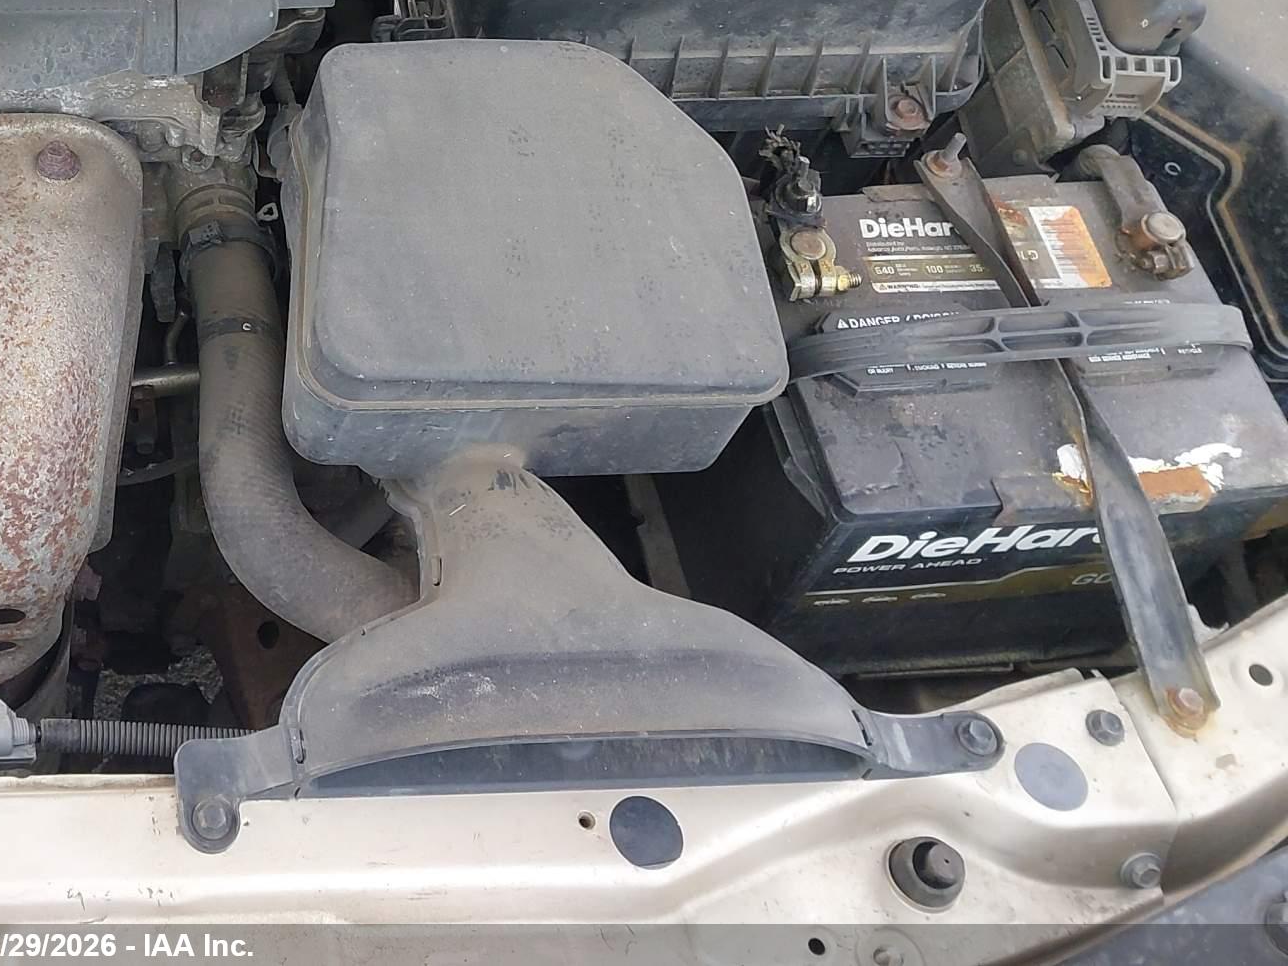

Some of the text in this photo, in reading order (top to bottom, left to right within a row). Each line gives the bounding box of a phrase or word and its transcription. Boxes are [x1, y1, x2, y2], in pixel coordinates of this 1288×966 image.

[859, 217, 955, 239] DieHar
[874, 265, 895, 275] 640
[925, 265, 944, 274] 100
[832, 558, 982, 575] POWER AHEAD
